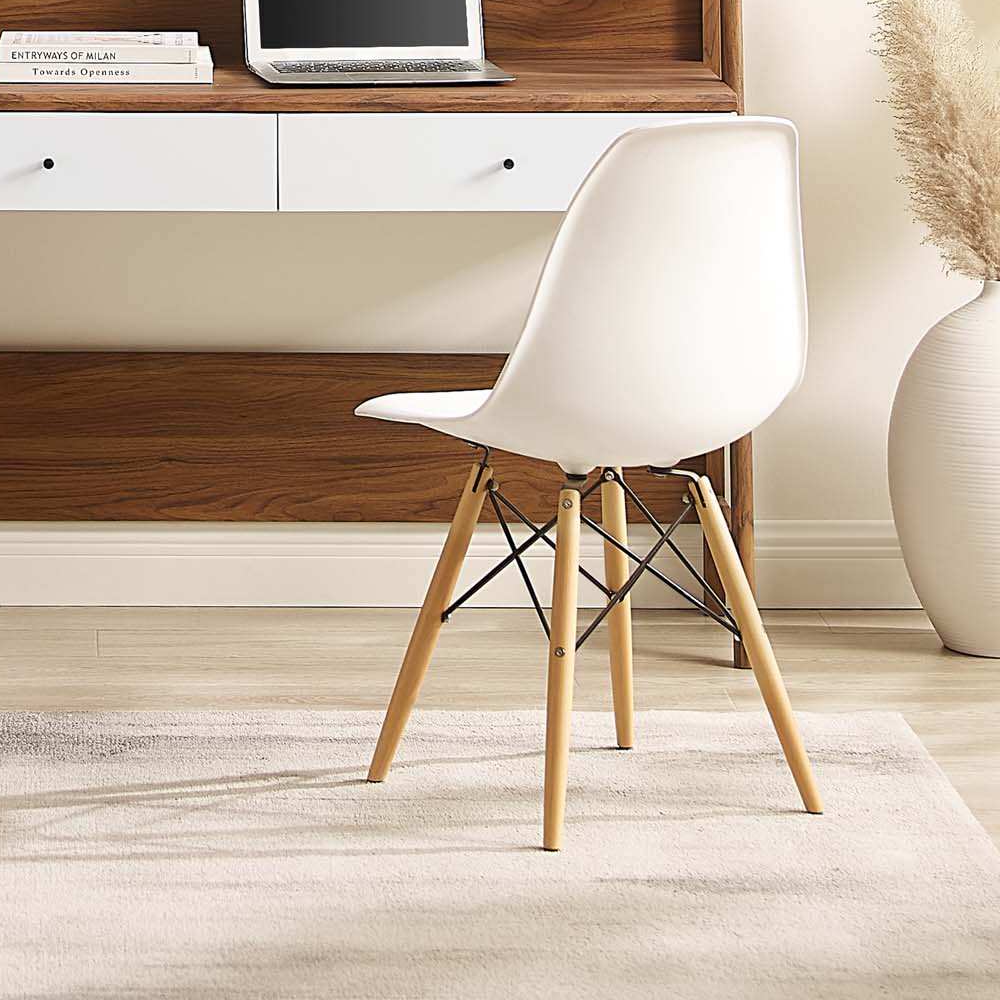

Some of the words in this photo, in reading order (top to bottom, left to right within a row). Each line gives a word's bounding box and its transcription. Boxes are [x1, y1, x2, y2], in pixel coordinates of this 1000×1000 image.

[11, 51, 68, 60] ENTRYWAYS
[70, 51, 84, 60] OF
[86, 51, 117, 61] MILAN
[32, 67, 77, 76] Towards
[80, 67, 131, 78] Openness
